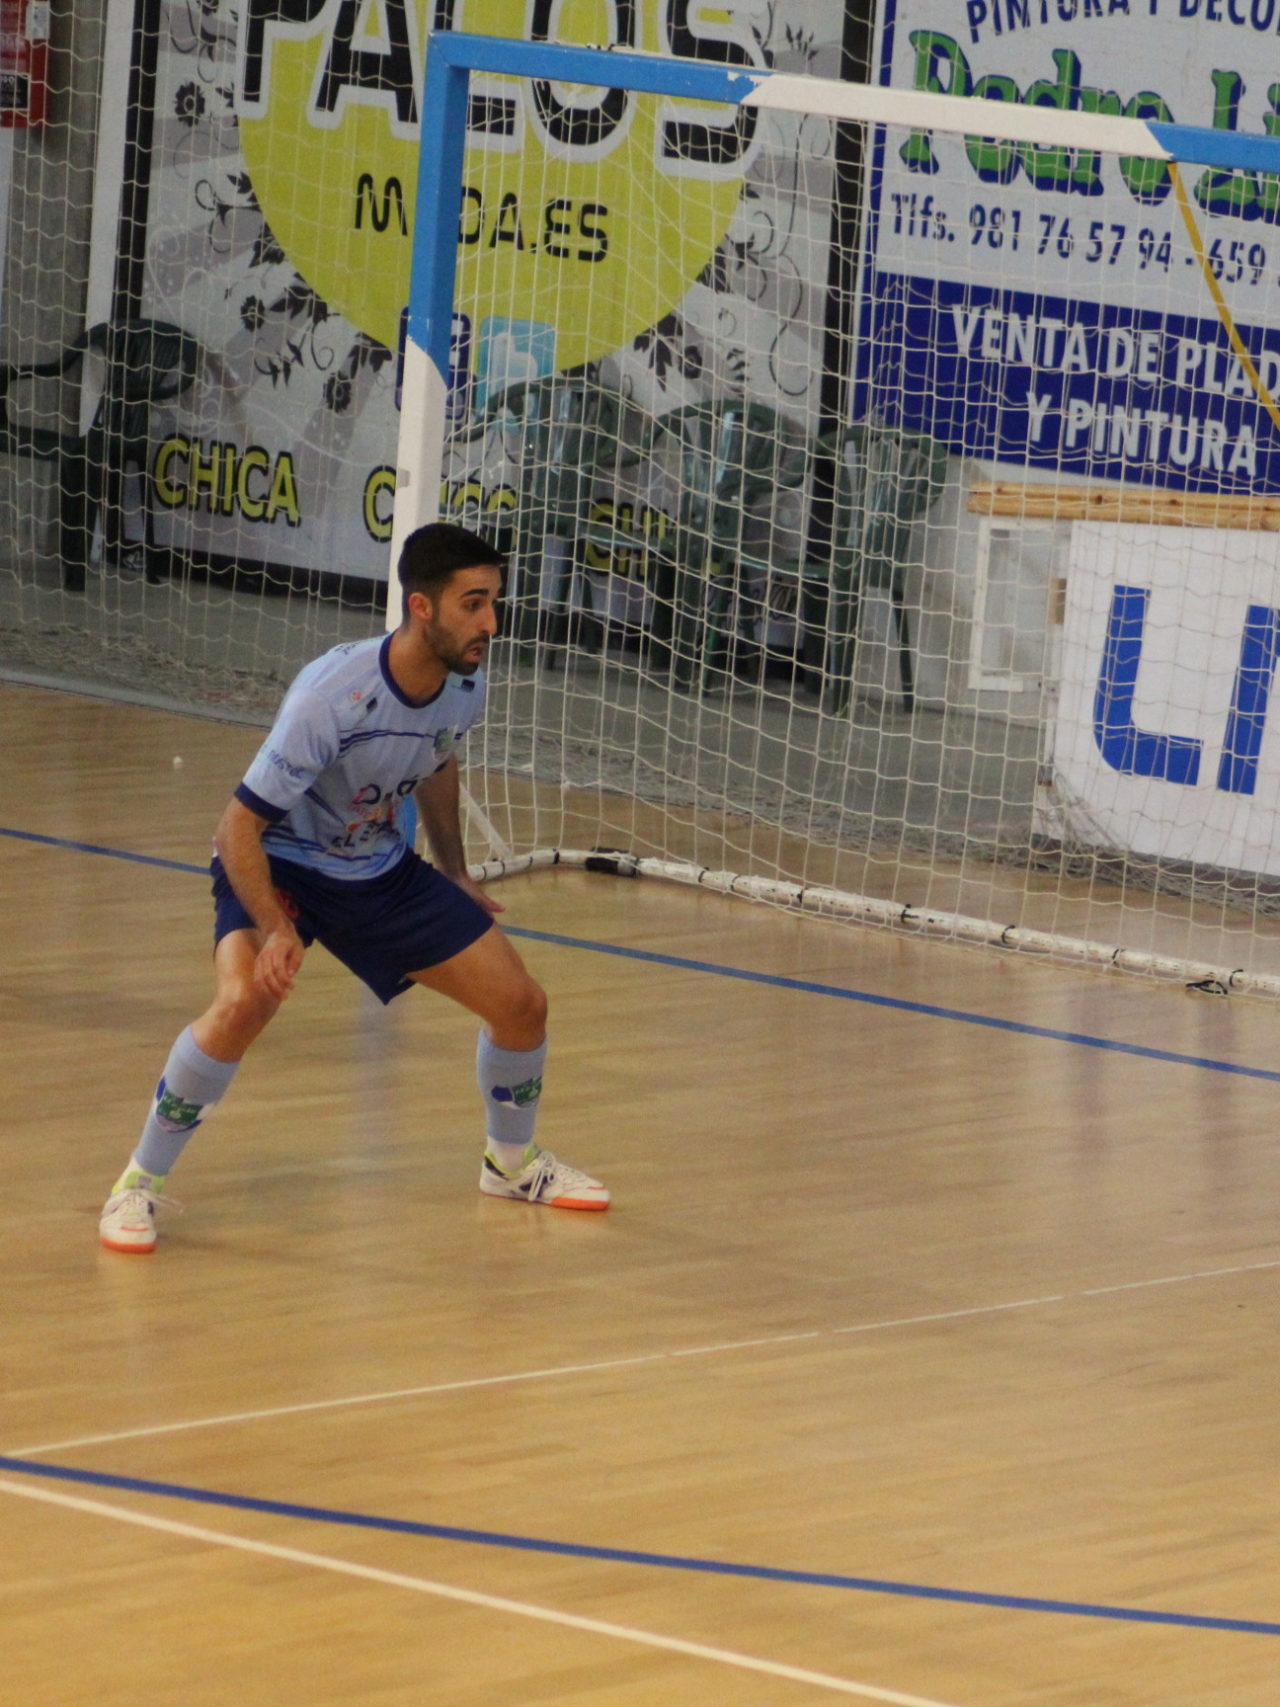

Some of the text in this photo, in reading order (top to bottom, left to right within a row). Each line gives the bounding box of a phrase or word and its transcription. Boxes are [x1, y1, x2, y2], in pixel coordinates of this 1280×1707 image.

[243, 0, 758, 164] PAOS
[900, 29, 1176, 206] Pedro
[355, 172, 608, 262] MDA.ES
[968, 205, 1021, 250] 981
[1038, 214, 1075, 260] 76
[1085, 222, 1127, 265] 57
[1137, 229, 1172, 272] 94
[1208, 239, 1266, 286] 659
[953, 305, 1090, 372] VENTA
[1106, 325, 1160, 385] DE
[1026, 391, 1257, 476] Y PINTURA
[155, 434, 300, 529] CHICA
[362, 464, 518, 553] CICO
